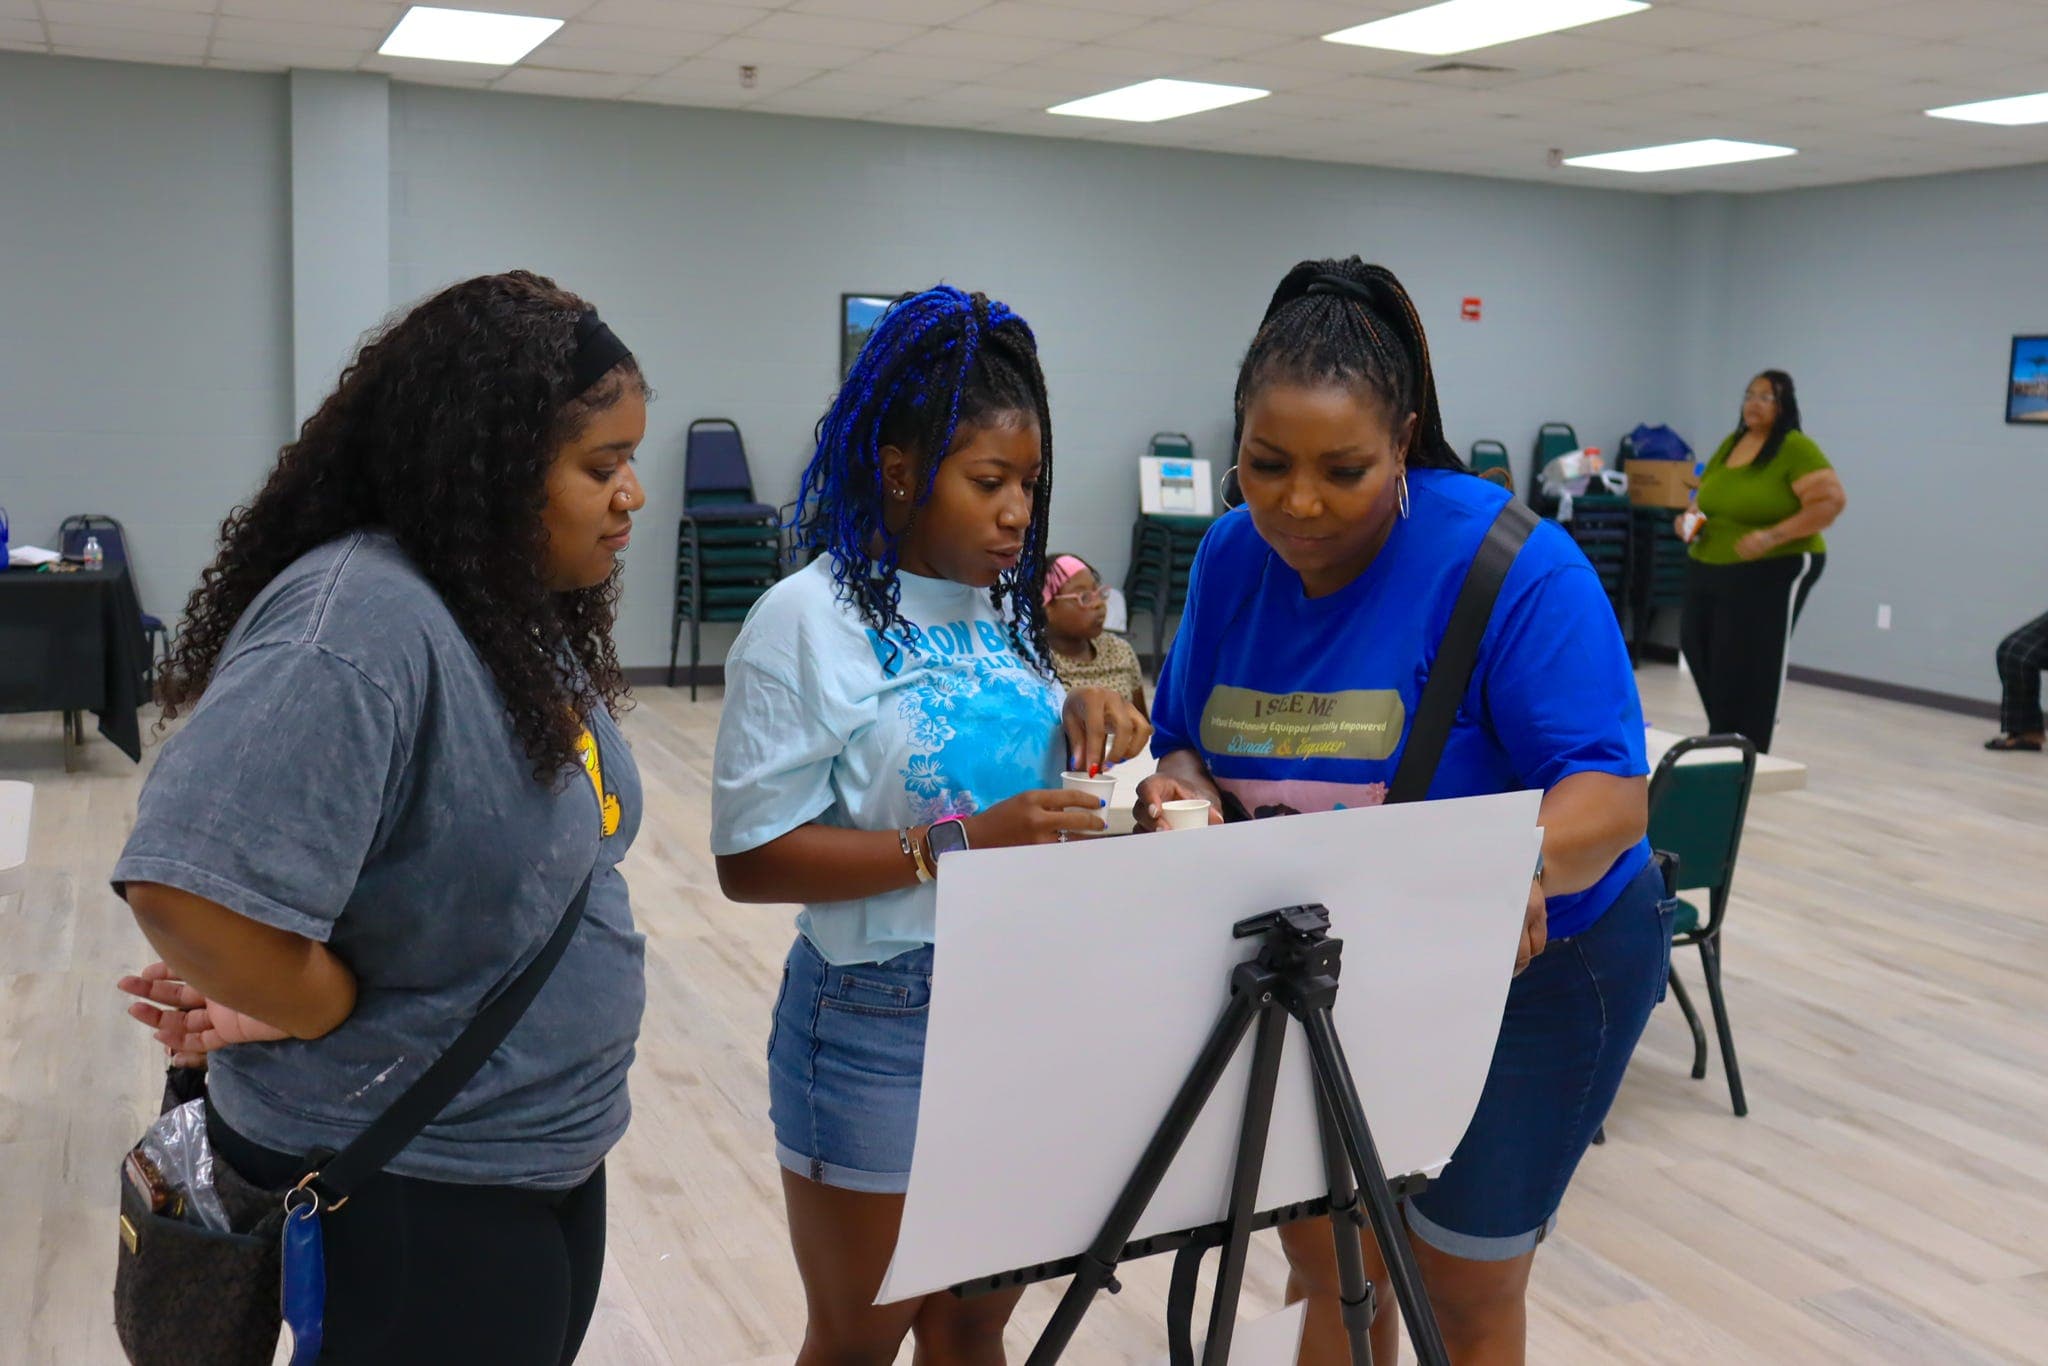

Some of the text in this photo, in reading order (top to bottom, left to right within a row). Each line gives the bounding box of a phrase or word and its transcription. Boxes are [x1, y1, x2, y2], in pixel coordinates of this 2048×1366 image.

[1255, 694, 1337, 718] I SEE ME
[1269, 721, 1311, 736] Equipped
[1339, 720, 1387, 734] Empowered
[1227, 733, 1274, 755] Donate
